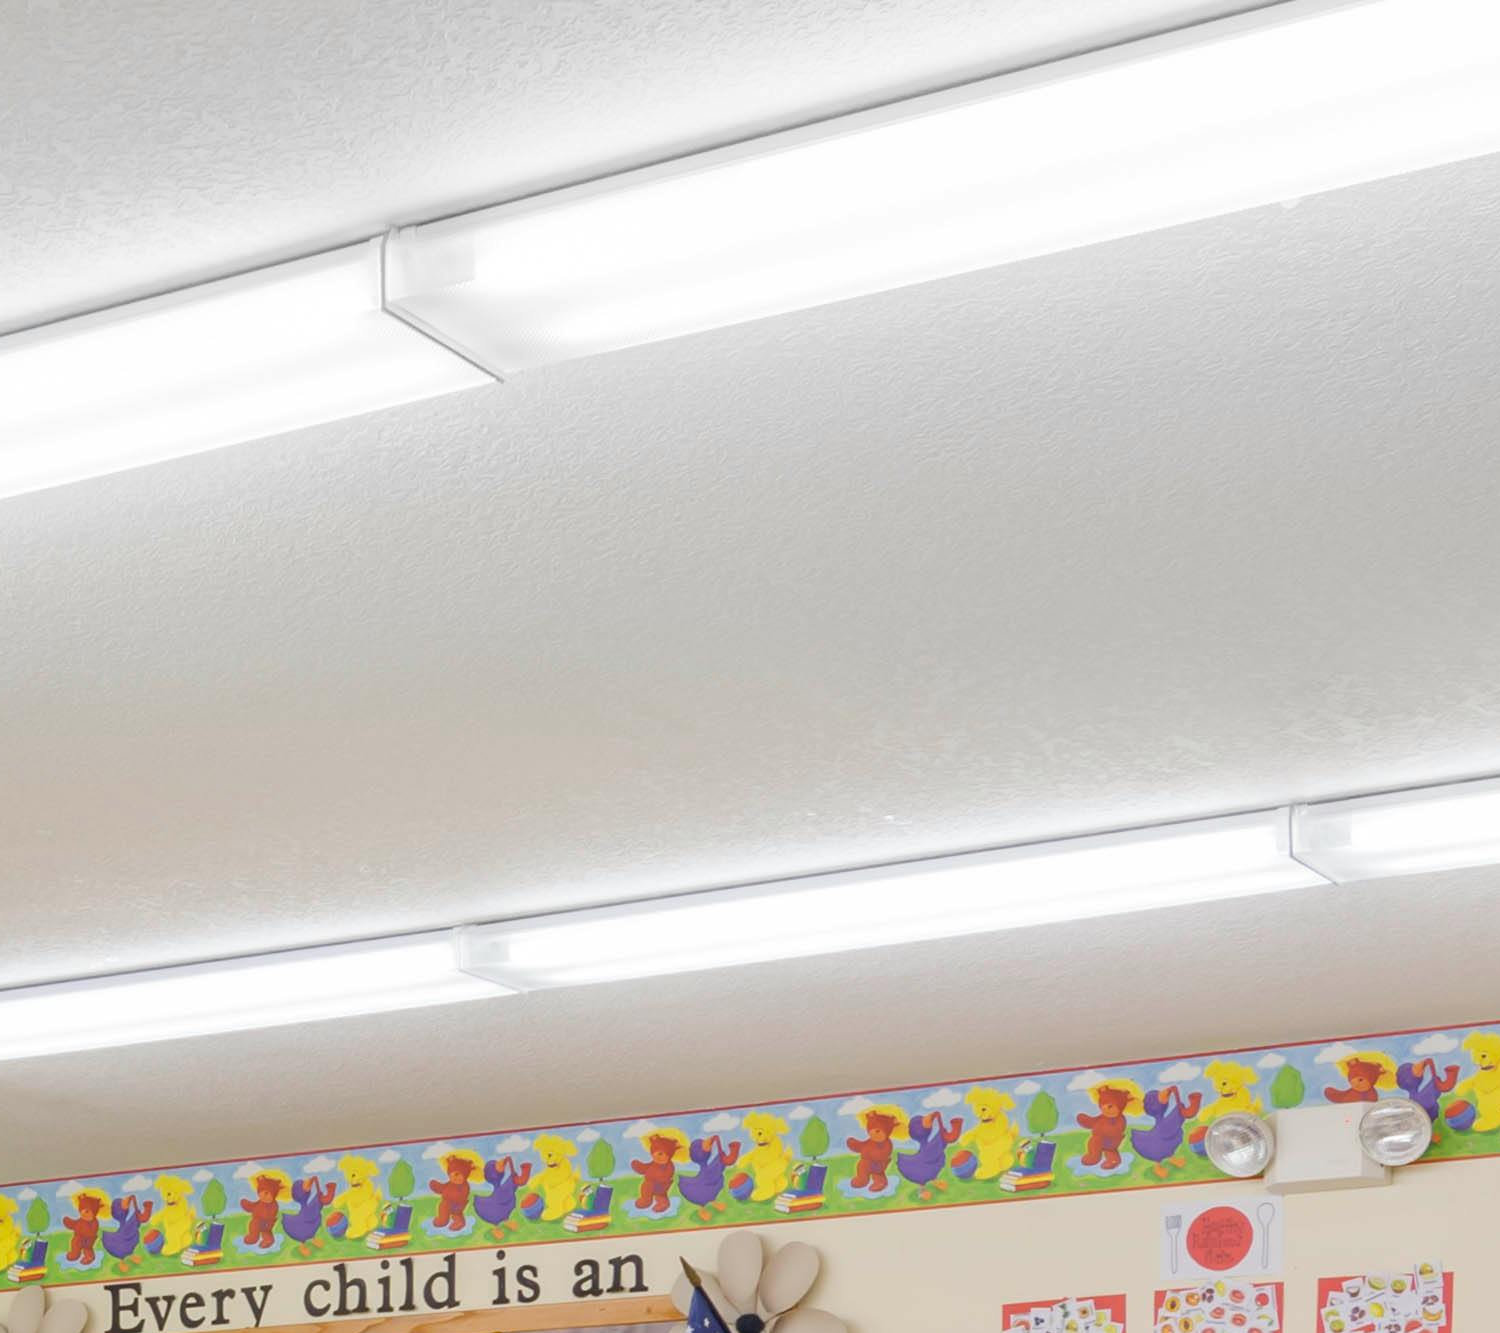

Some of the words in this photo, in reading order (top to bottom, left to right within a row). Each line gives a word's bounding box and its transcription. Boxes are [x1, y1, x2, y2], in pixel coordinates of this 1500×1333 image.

[302, 1253, 460, 1318] child
[491, 1251, 541, 1306] is
[571, 1251, 650, 1299] an
